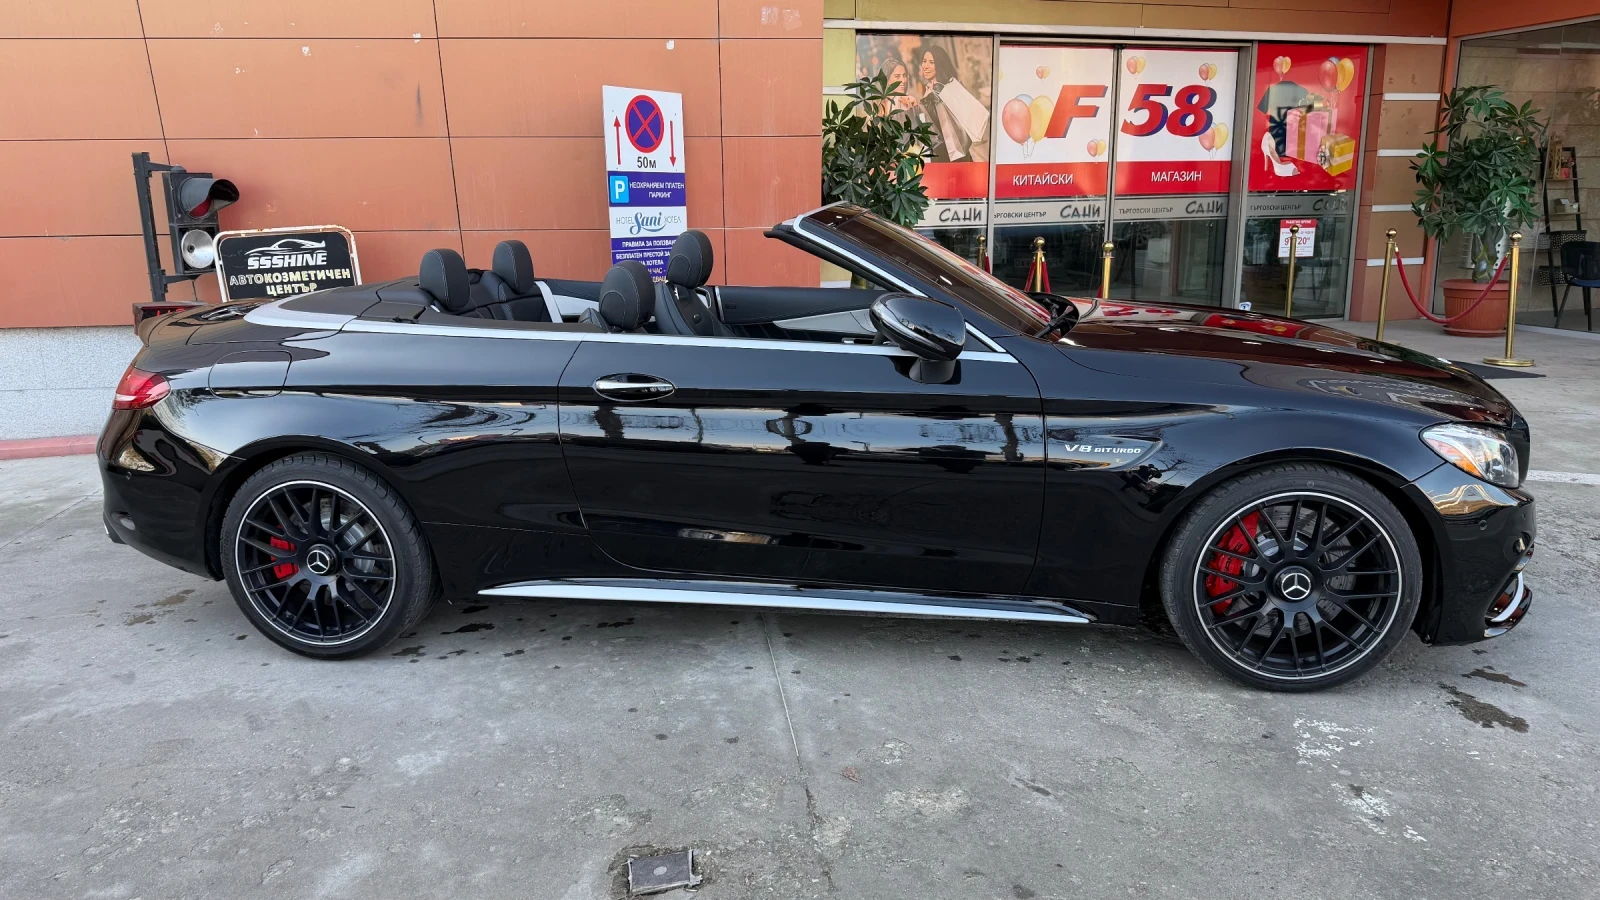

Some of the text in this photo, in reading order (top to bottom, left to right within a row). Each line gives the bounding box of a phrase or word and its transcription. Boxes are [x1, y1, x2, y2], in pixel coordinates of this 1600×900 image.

[1044, 84, 1217, 138] F 58
[629, 181, 664, 189] НЕОХРАНЯЕМ
[1012, 171, 1202, 186] КИТАЙСКИ МАГАЗИН
[614, 180, 626, 199] P
[1023, 211, 1047, 219] ЦЕНТЪР
[1118, 207, 1151, 215] ТЪРГОВСКИ
[1151, 206, 1174, 214] ЦЕНТЪР
[616, 211, 662, 235] HOTEL Sani
[622, 240, 645, 248] ПРАВИЛА
[653, 239, 677, 247] ПОЛЗВАН
[247, 253, 327, 269] SSSHINE
[615, 252, 643, 260] БЕЗПЛАТЕН
[643, 250, 664, 258] ПРЕСТОЙ
[229, 269, 351, 286] АВТОКОЗМЕТИЧЕН
[266, 282, 318, 297] ЦЕНТЪР
[1064, 444, 1092, 453] V8
